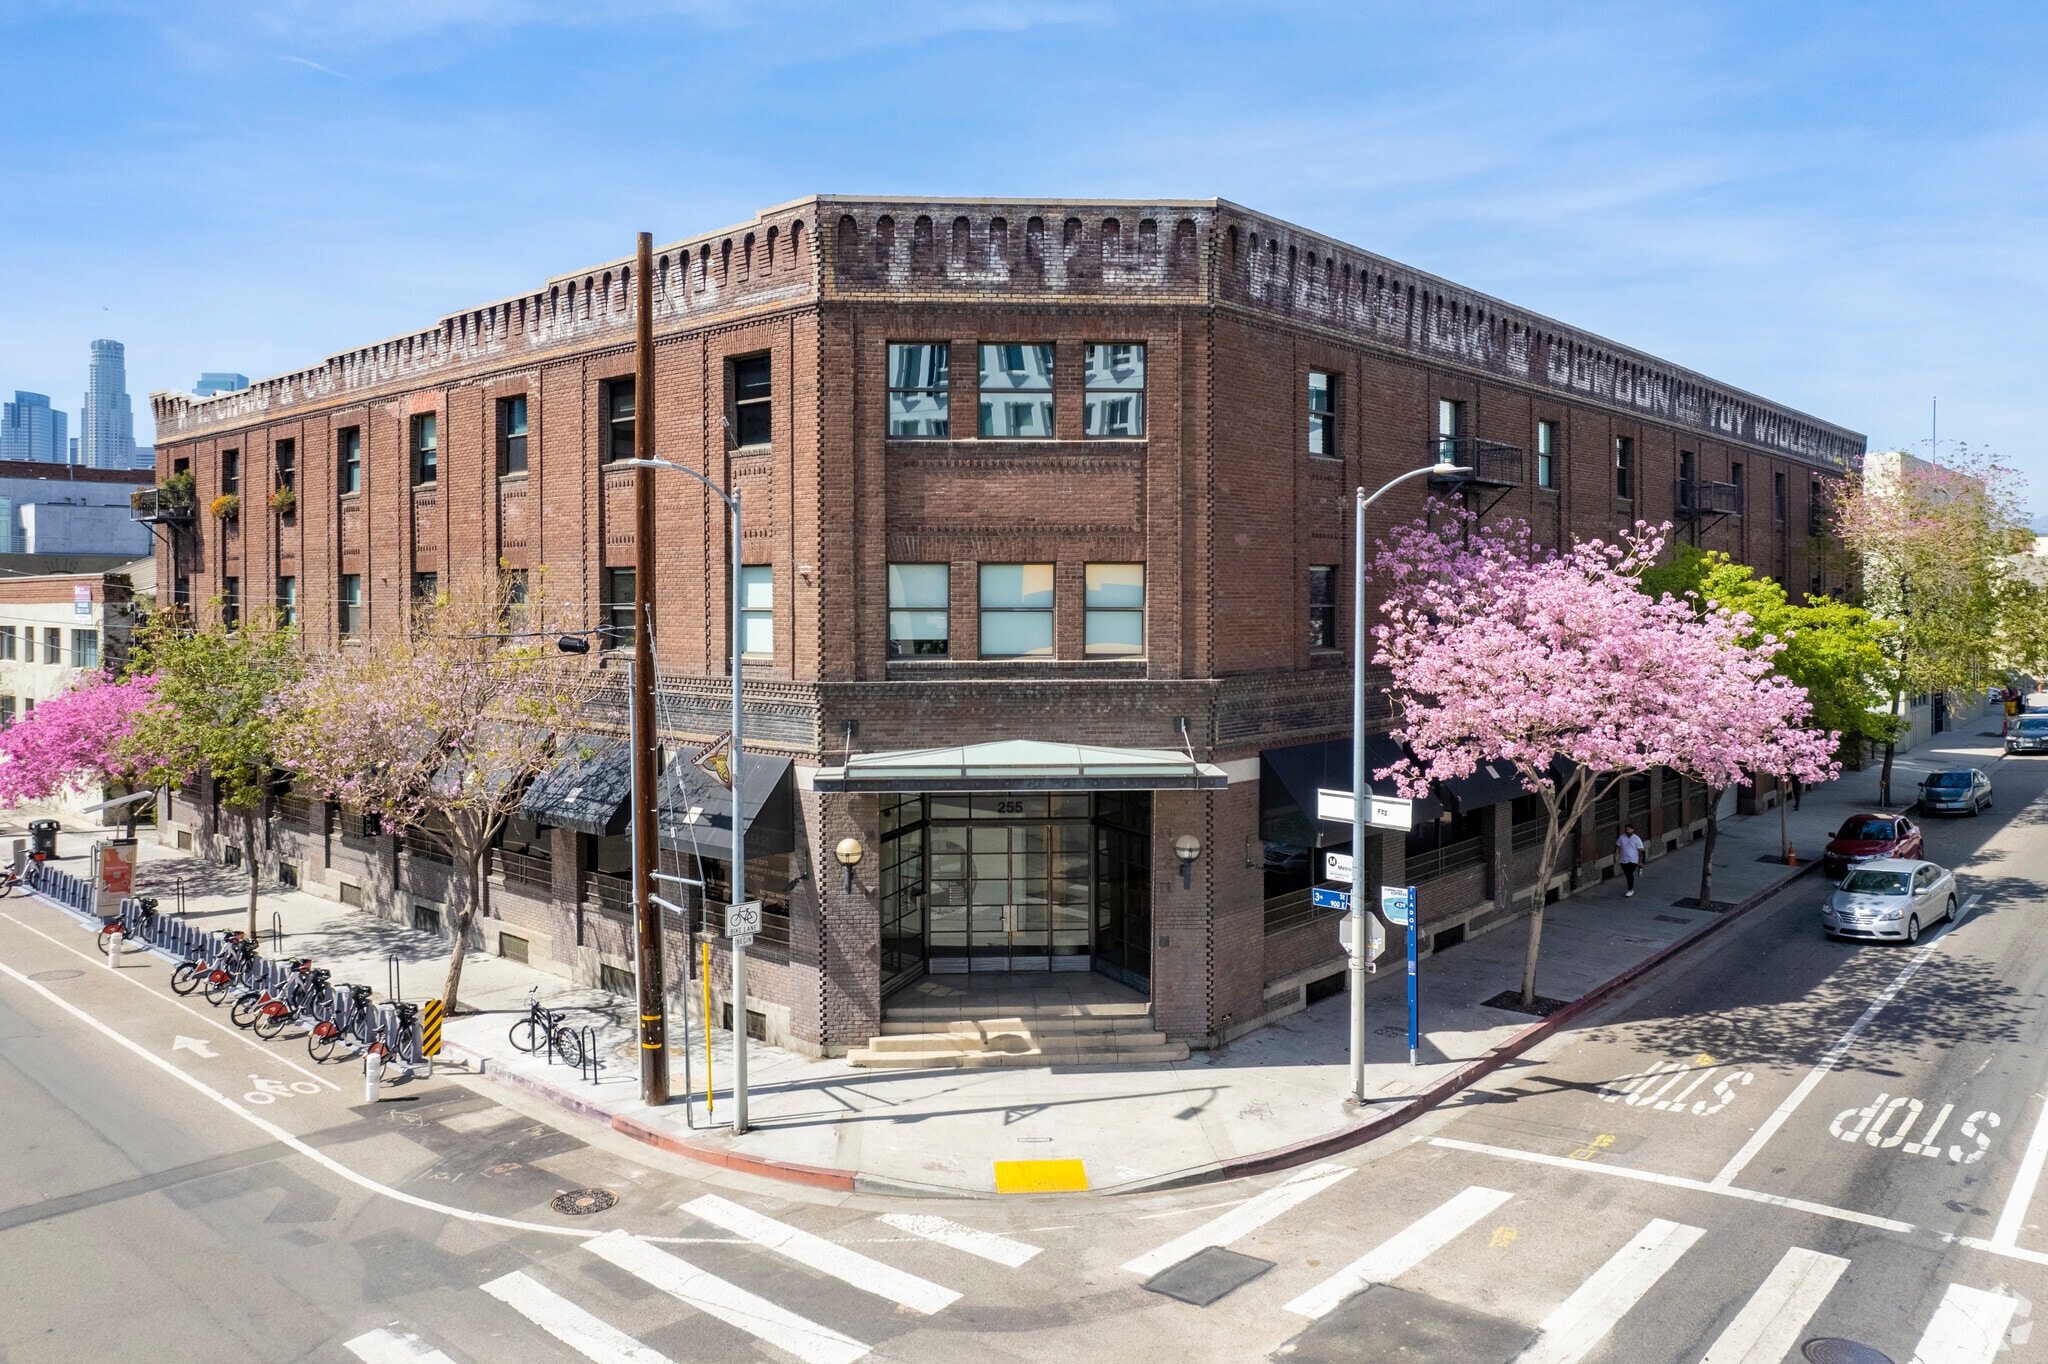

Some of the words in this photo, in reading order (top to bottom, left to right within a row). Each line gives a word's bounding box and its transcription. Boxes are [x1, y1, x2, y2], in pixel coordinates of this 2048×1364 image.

[344, 310, 510, 389] WHOLESALE
[1546, 338, 1670, 416] GORDON
[1709, 397, 1748, 435] TOY
[997, 801, 1023, 814] 255
[1330, 900, 1341, 909] 900
[729, 927, 742, 935] BIKE
[743, 924, 757, 933] LANE
[736, 936, 752, 946] BEGIN
[1597, 1060, 1754, 1116] STOP
[1829, 1093, 2001, 1164] STOP
